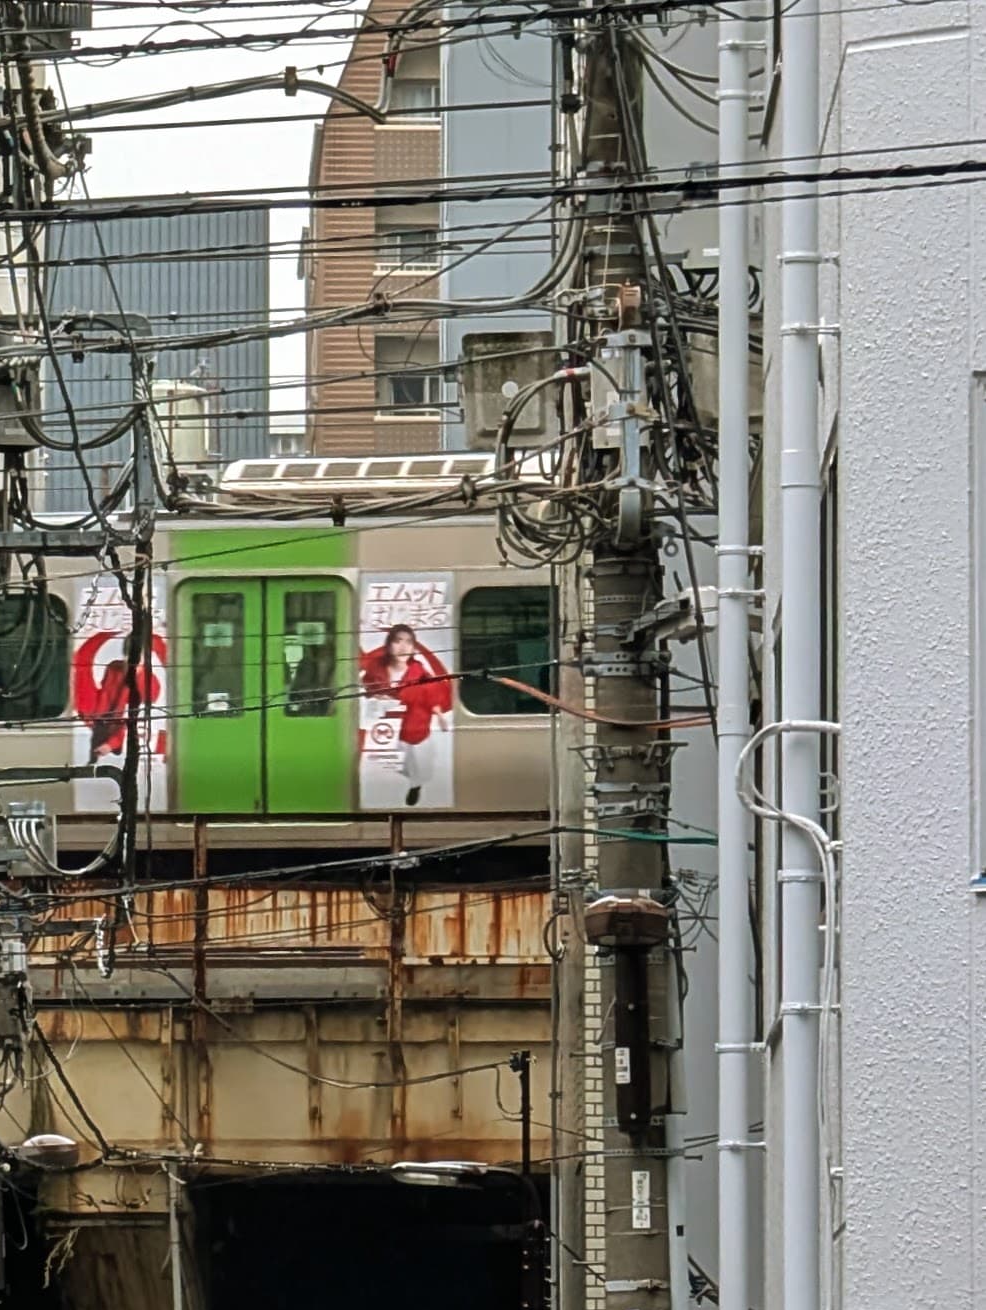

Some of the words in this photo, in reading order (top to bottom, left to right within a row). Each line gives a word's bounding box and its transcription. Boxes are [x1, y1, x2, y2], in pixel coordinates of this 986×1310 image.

[366, 583, 444, 604] エムット
[367, 605, 447, 627] はじまる
